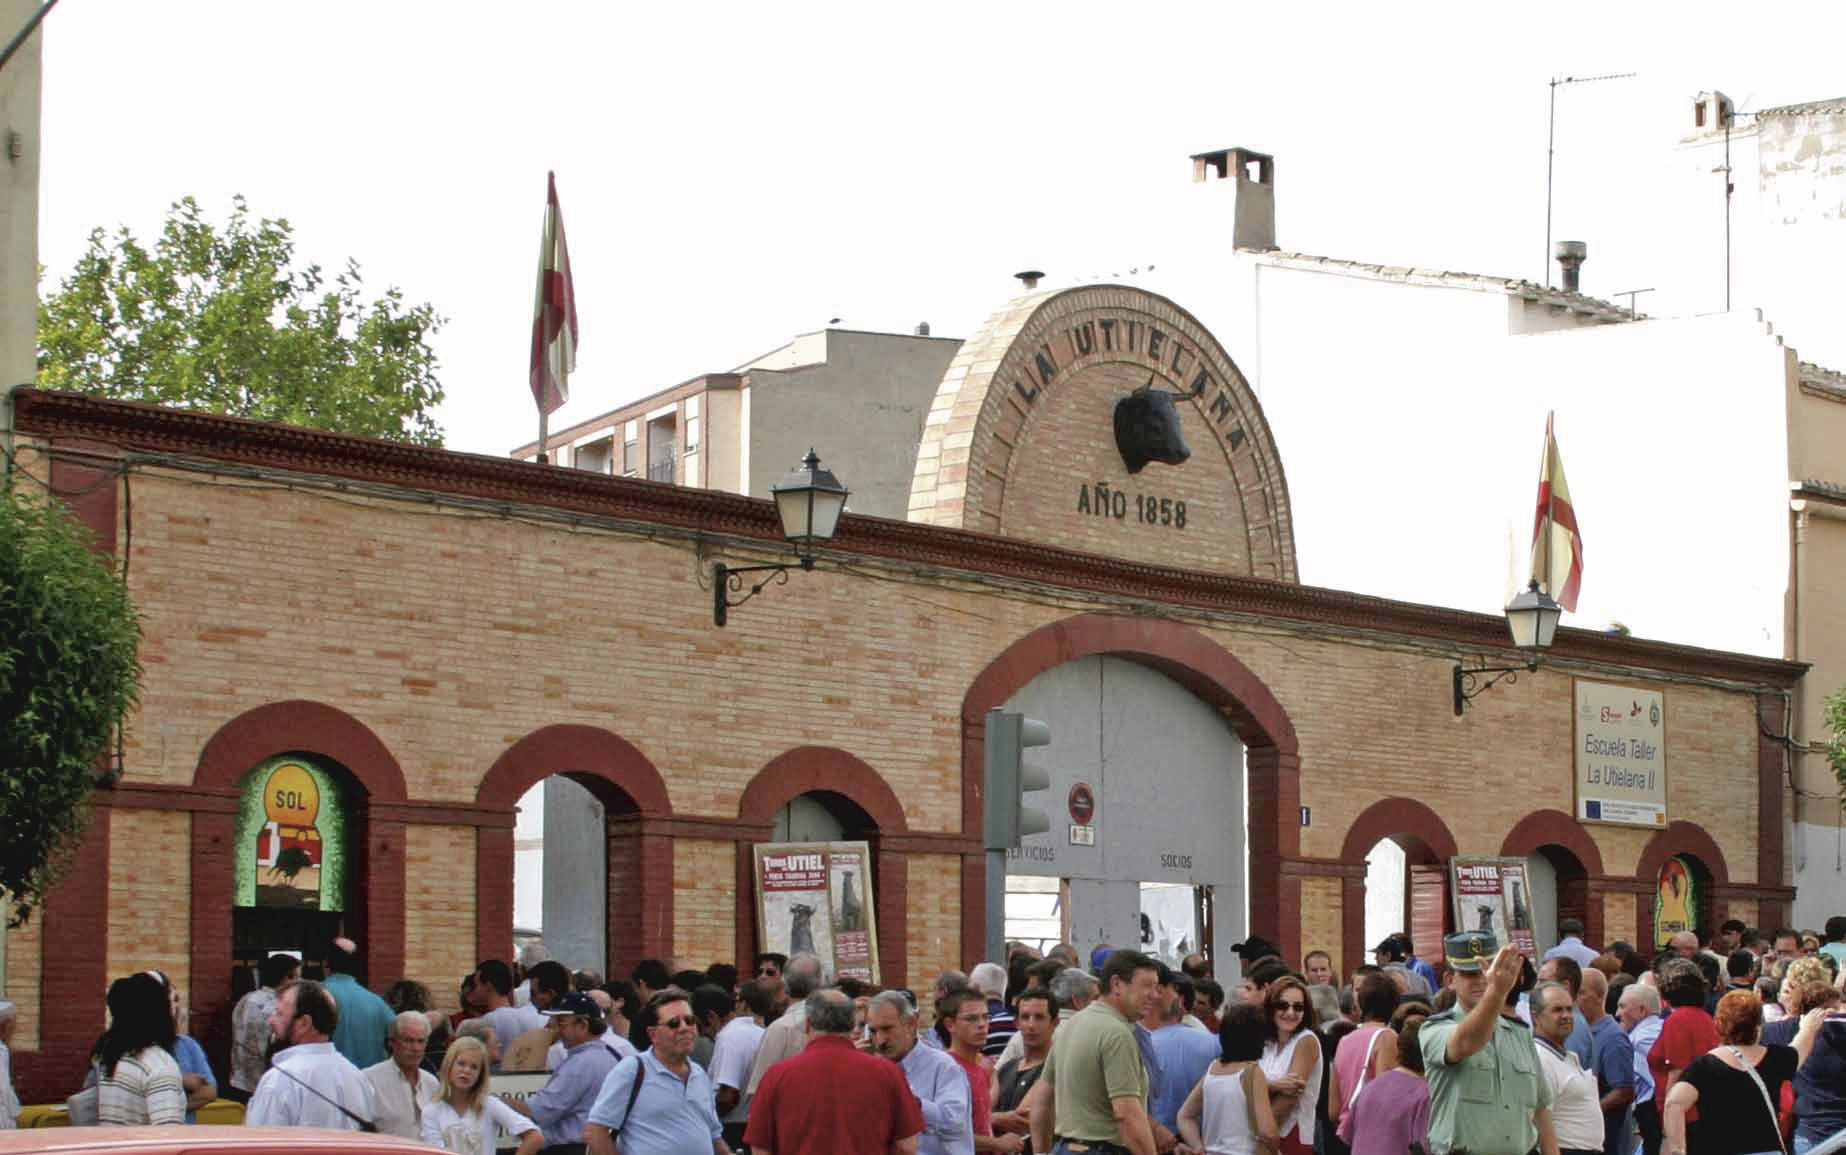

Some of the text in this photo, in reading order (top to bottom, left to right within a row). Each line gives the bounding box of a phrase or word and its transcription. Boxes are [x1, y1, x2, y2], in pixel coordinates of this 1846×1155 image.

[1014, 318, 1246, 452] LA UTIELANA
[1077, 482, 1187, 529] AÑO 1858
[1585, 734, 1656, 760] Escuela Taller
[1587, 763, 1600, 784] La
[1604, 764, 1645, 789] Utielana
[275, 789, 306, 811] SOL
[787, 855, 825, 871] UTIEL
[1160, 853, 1193, 870] SOCIOS
[1473, 866, 1499, 879] UTIEL
